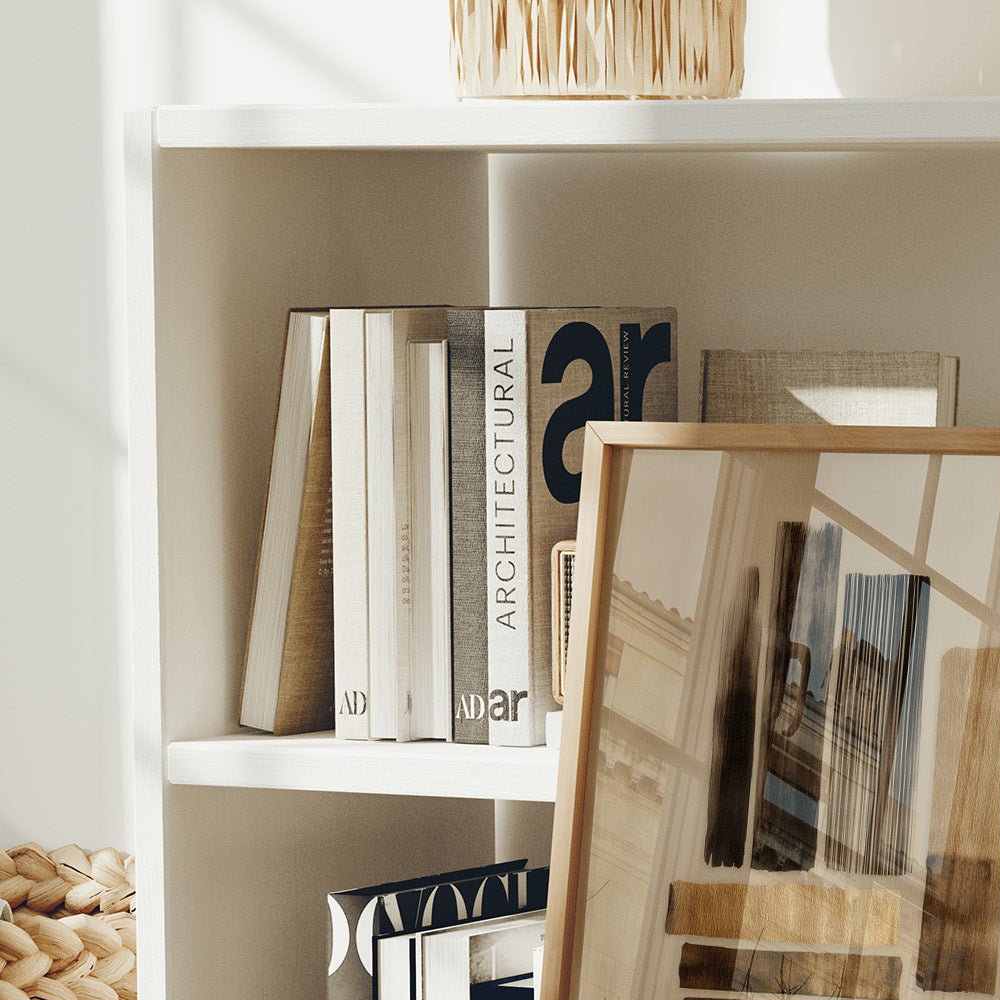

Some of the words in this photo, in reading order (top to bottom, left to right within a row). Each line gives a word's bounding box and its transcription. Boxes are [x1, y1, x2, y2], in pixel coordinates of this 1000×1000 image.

[622, 330, 630, 379] REVIEW
[541, 321, 671, 504] ar
[622, 384, 630, 421] URAL
[493, 337, 516, 630] ARCHITECTURAL
[339, 690, 367, 716] AD
[456, 694, 485, 720] AD
[489, 688, 528, 722] ar
